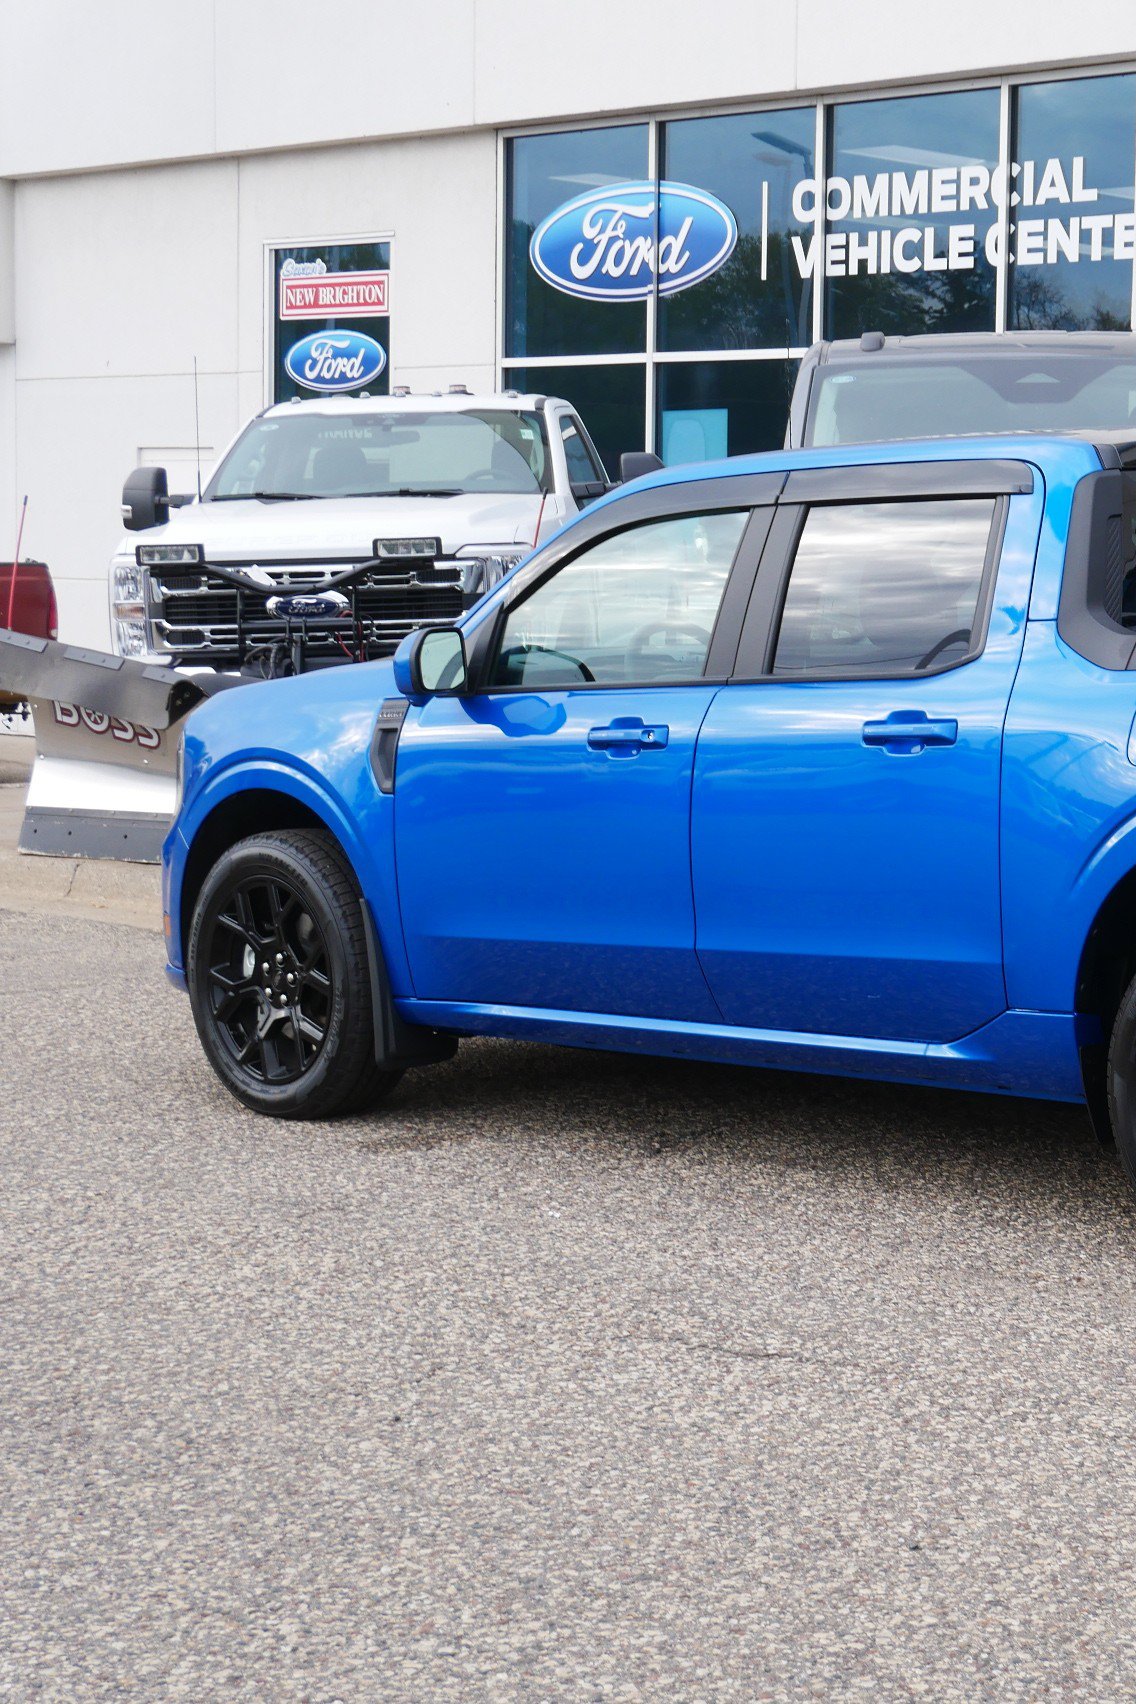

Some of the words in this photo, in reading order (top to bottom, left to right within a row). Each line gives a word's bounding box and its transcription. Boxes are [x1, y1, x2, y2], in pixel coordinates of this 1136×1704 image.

[793, 156, 1098, 223] COMMERCIAL
[570, 202, 693, 280] Ford
[791, 224, 975, 279] VEHICLE
[984, 213, 1134, 267] CENTE
[286, 287, 316, 307] NEW
[318, 284, 384, 305] BRIGHTON
[304, 339, 366, 380] Ford
